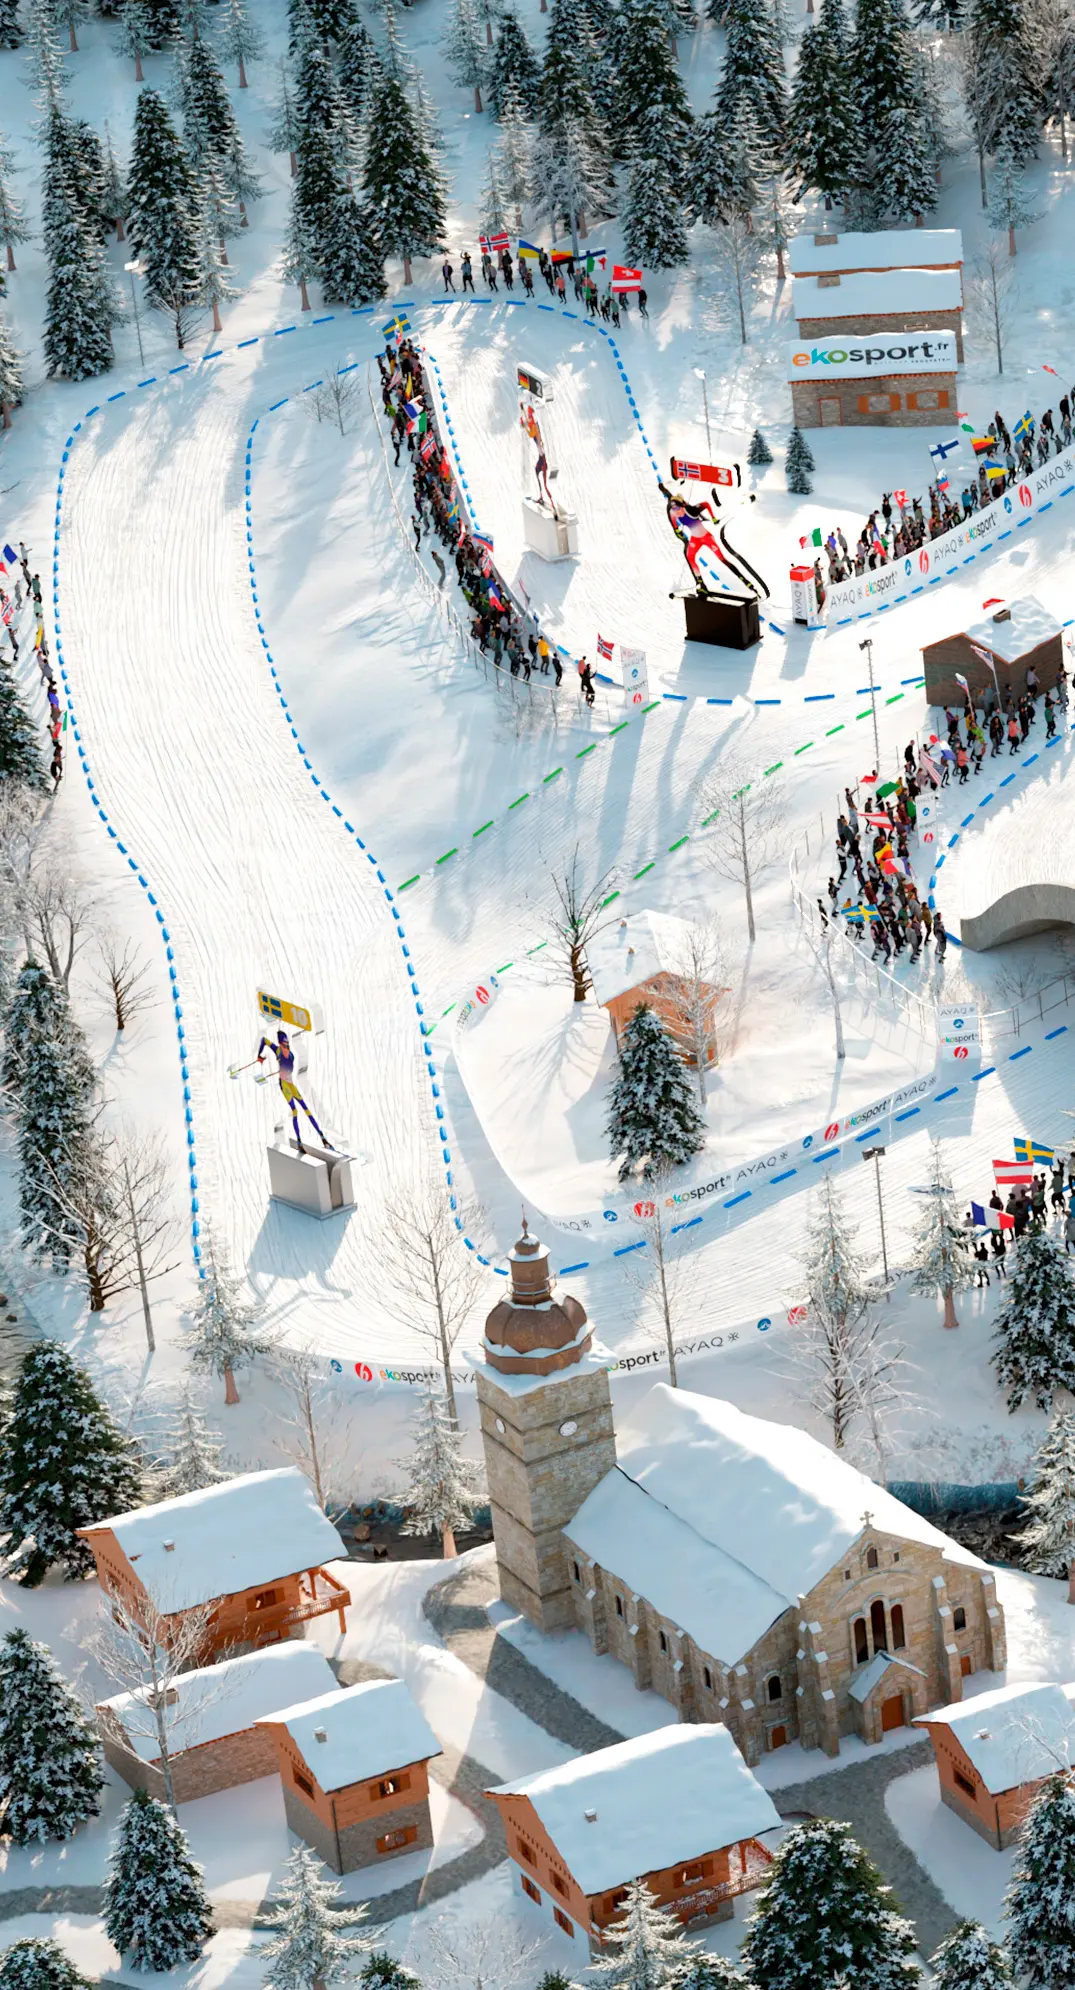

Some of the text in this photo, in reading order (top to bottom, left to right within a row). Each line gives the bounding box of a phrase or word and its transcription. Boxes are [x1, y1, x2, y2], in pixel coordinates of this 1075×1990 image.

[792, 342, 949, 367] ekosport.fr
[718, 468, 729, 484] 3
[1036, 466, 1065, 494] AYAQ
[933, 540, 957, 563] AYAQ
[831, 589, 856, 608] AYAQ
[291, 1007, 308, 1027] 10
[940, 1007, 967, 1016] AYAQ
[894, 1080, 927, 1105] AYAQ
[736, 1156, 776, 1182] AYAQ
[672, 1336, 724, 1357] AYAQ
